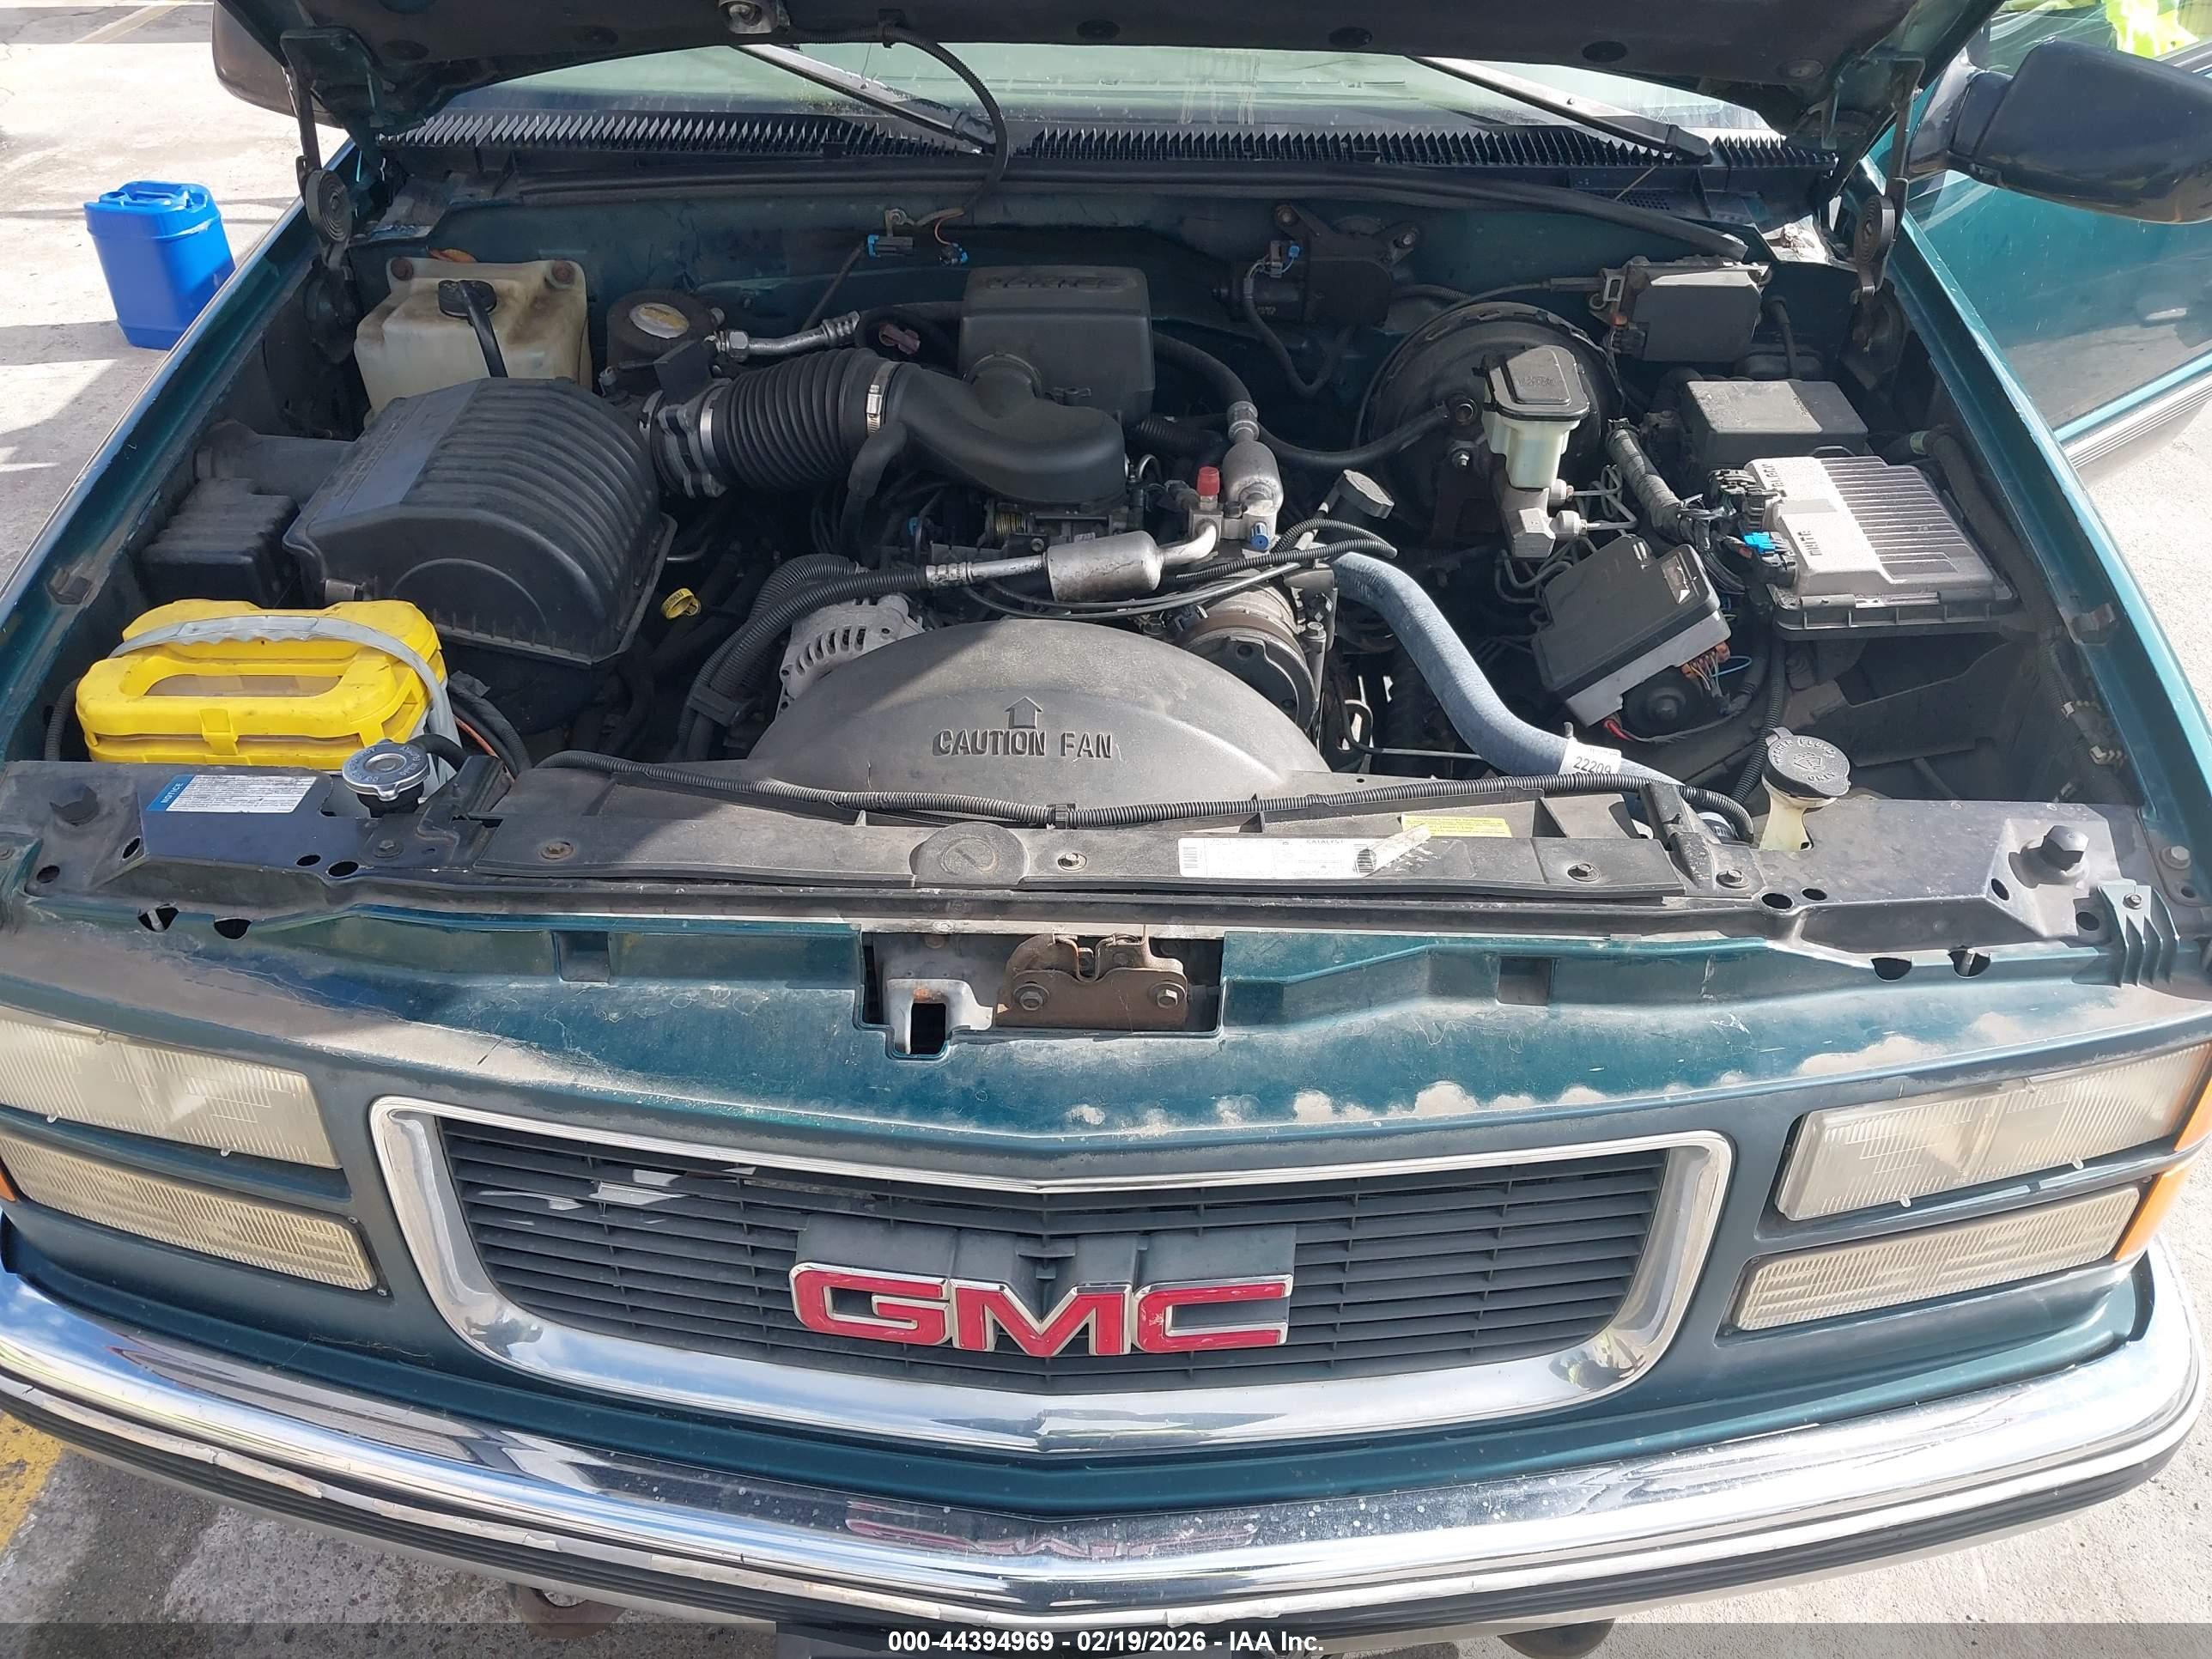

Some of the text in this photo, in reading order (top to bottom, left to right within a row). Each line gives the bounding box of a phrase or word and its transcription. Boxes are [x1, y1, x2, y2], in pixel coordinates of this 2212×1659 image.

[933, 729, 1113, 759] CAUTION FAN
[161, 782, 184, 805] NOTICE
[790, 1261, 1294, 1358] GMC
